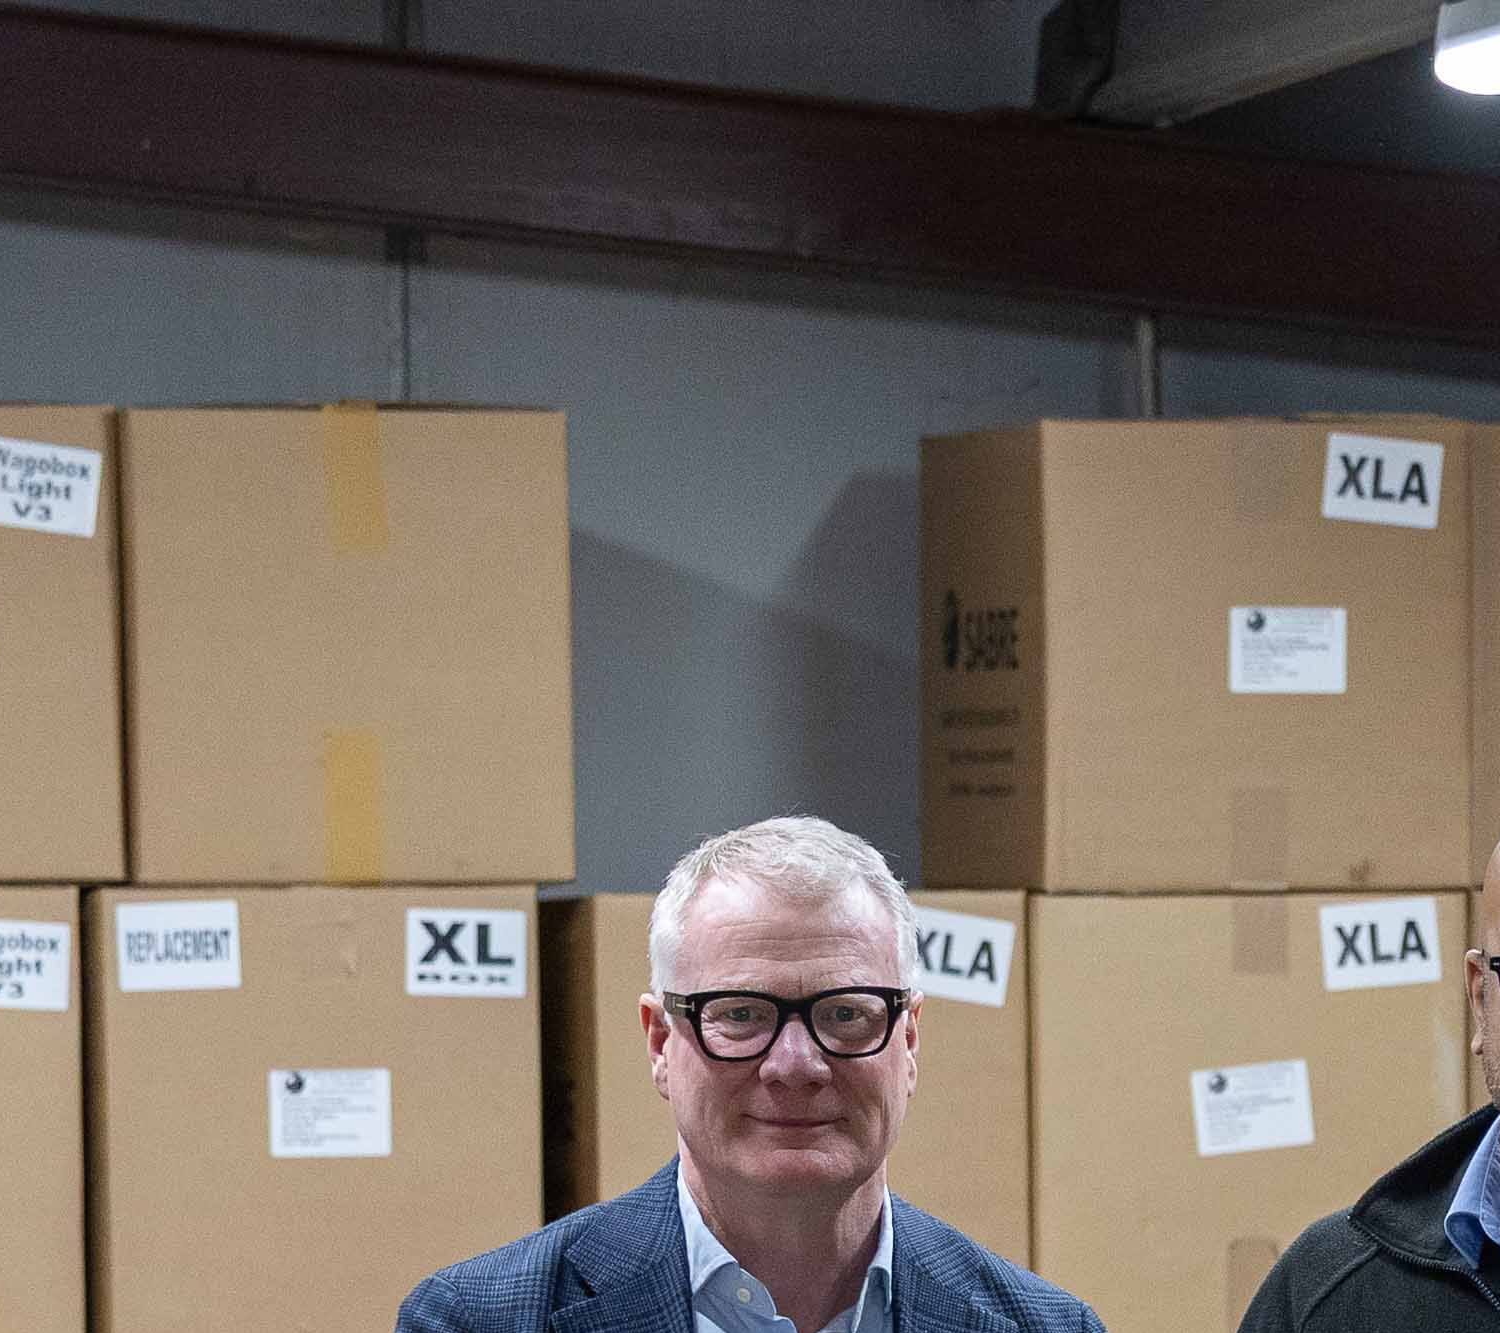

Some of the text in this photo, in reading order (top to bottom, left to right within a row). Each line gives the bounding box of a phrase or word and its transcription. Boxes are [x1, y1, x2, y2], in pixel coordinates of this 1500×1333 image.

[1, 474, 74, 500] Light
[1337, 453, 1429, 506] XLA
[12, 500, 53, 521] V3
[125, 928, 232, 964] REPLACEMENT
[420, 920, 515, 967] XL
[1335, 919, 1429, 967] XLA
